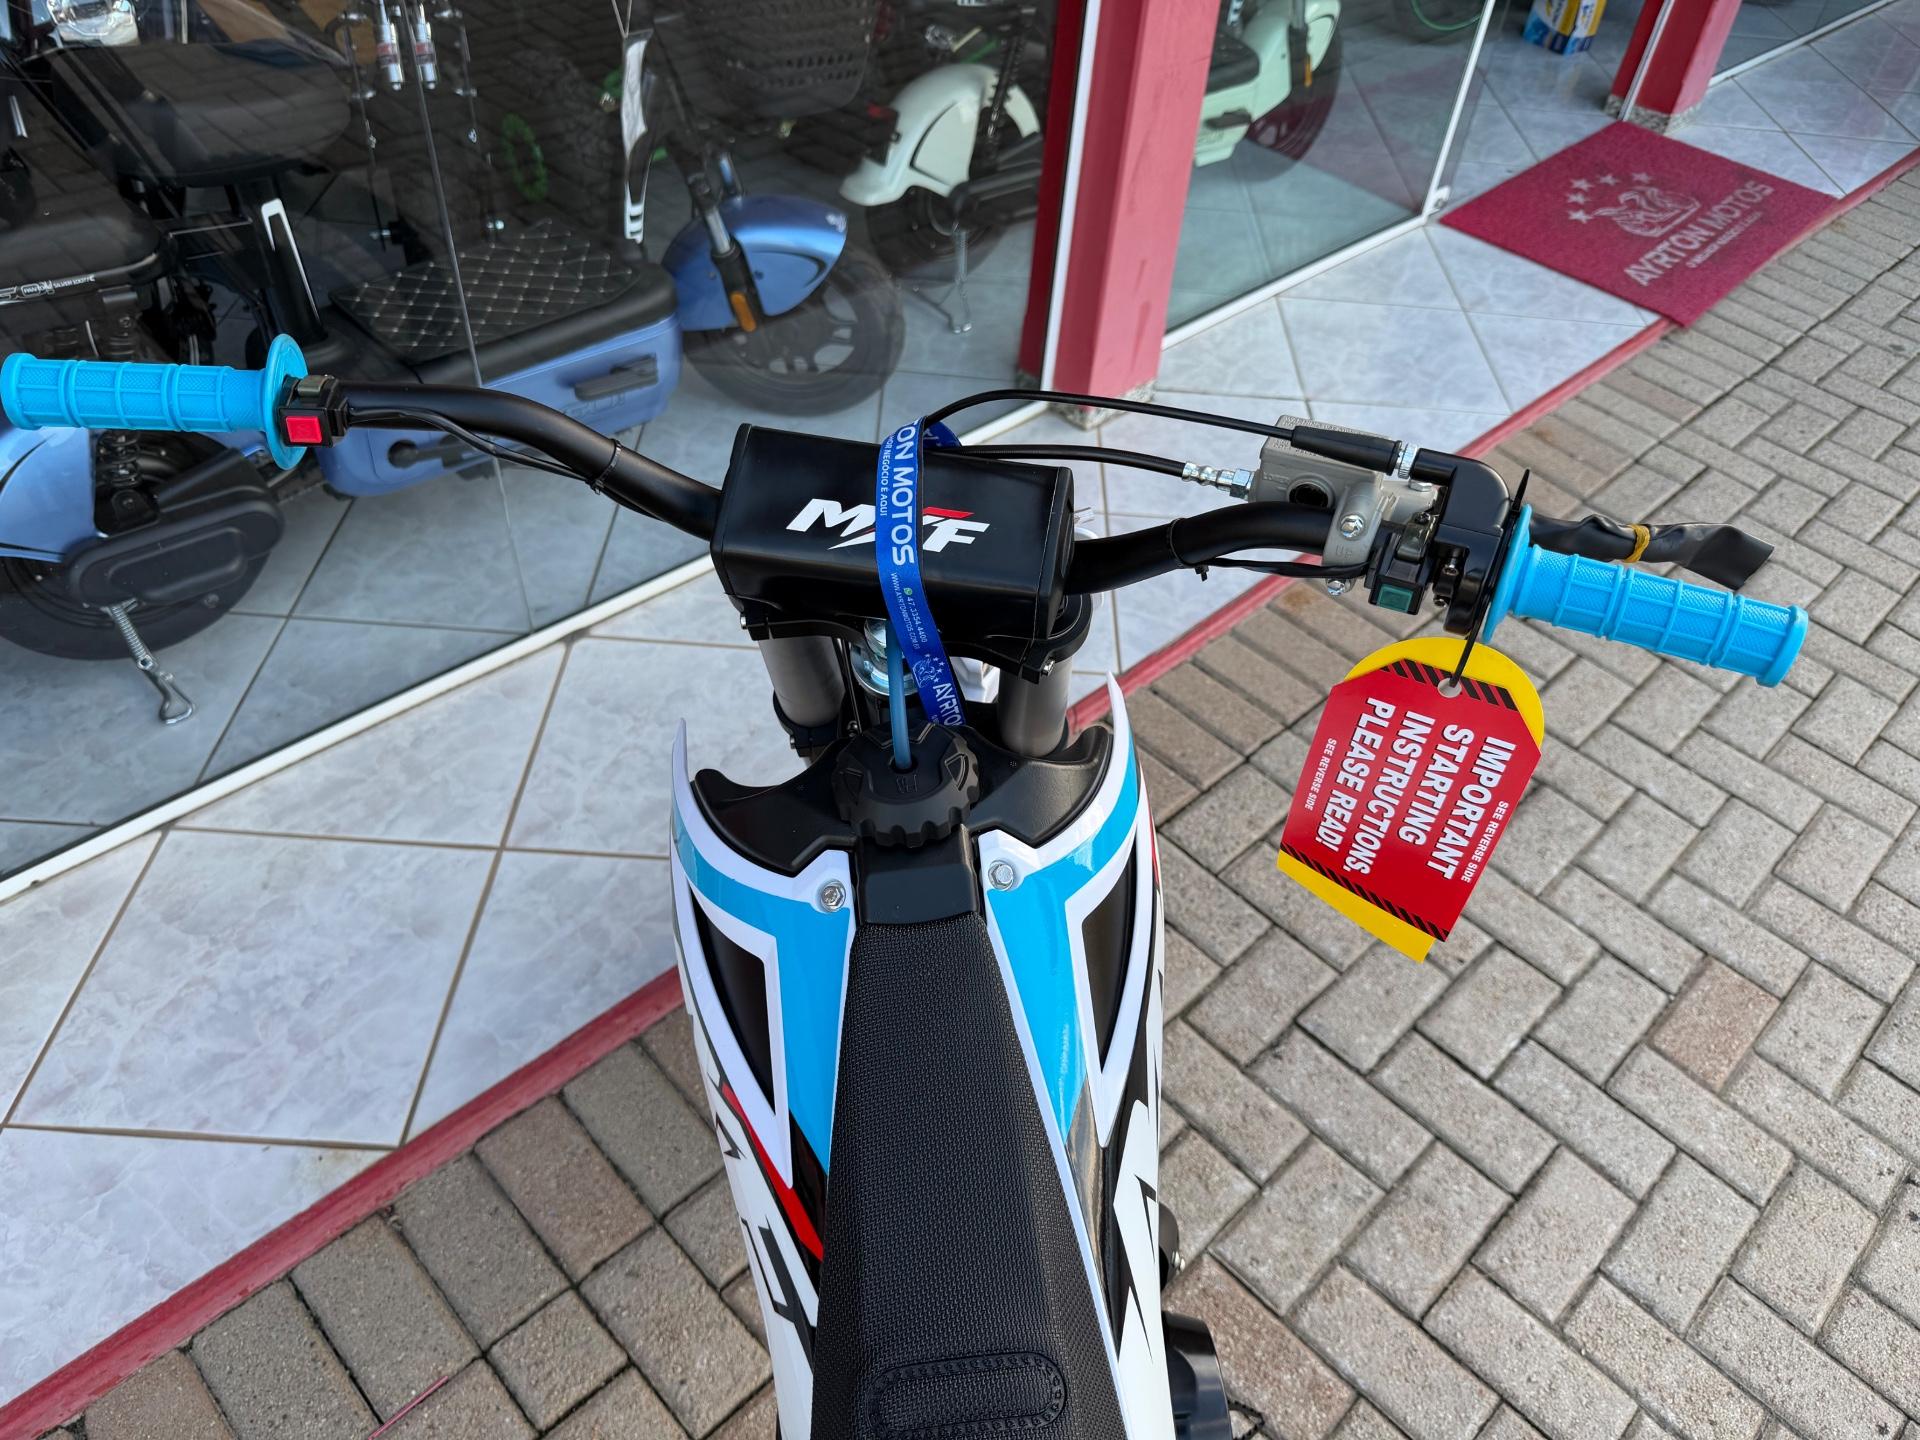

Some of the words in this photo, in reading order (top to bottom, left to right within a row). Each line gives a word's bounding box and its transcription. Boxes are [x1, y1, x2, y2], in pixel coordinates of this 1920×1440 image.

[1624, 224, 1715, 286] AYRTON
[1697, 182, 1775, 230] MOTOS
[880, 494, 888, 516] AQUI
[891, 466, 914, 566] MOTOS
[1324, 738, 1337, 756] SEE
[1336, 698, 1396, 792] PLEASE
[1311, 756, 1331, 795] REVERSE
[1398, 724, 1475, 845] STARTING
[1305, 792, 1318, 811] SIDE
[1315, 790, 1358, 852] READ!
[1426, 736, 1516, 880] IMPORTANT
[1493, 800, 1509, 820] SEE
[1471, 821, 1499, 862] REVERSE
[1461, 863, 1478, 883] SIDE
